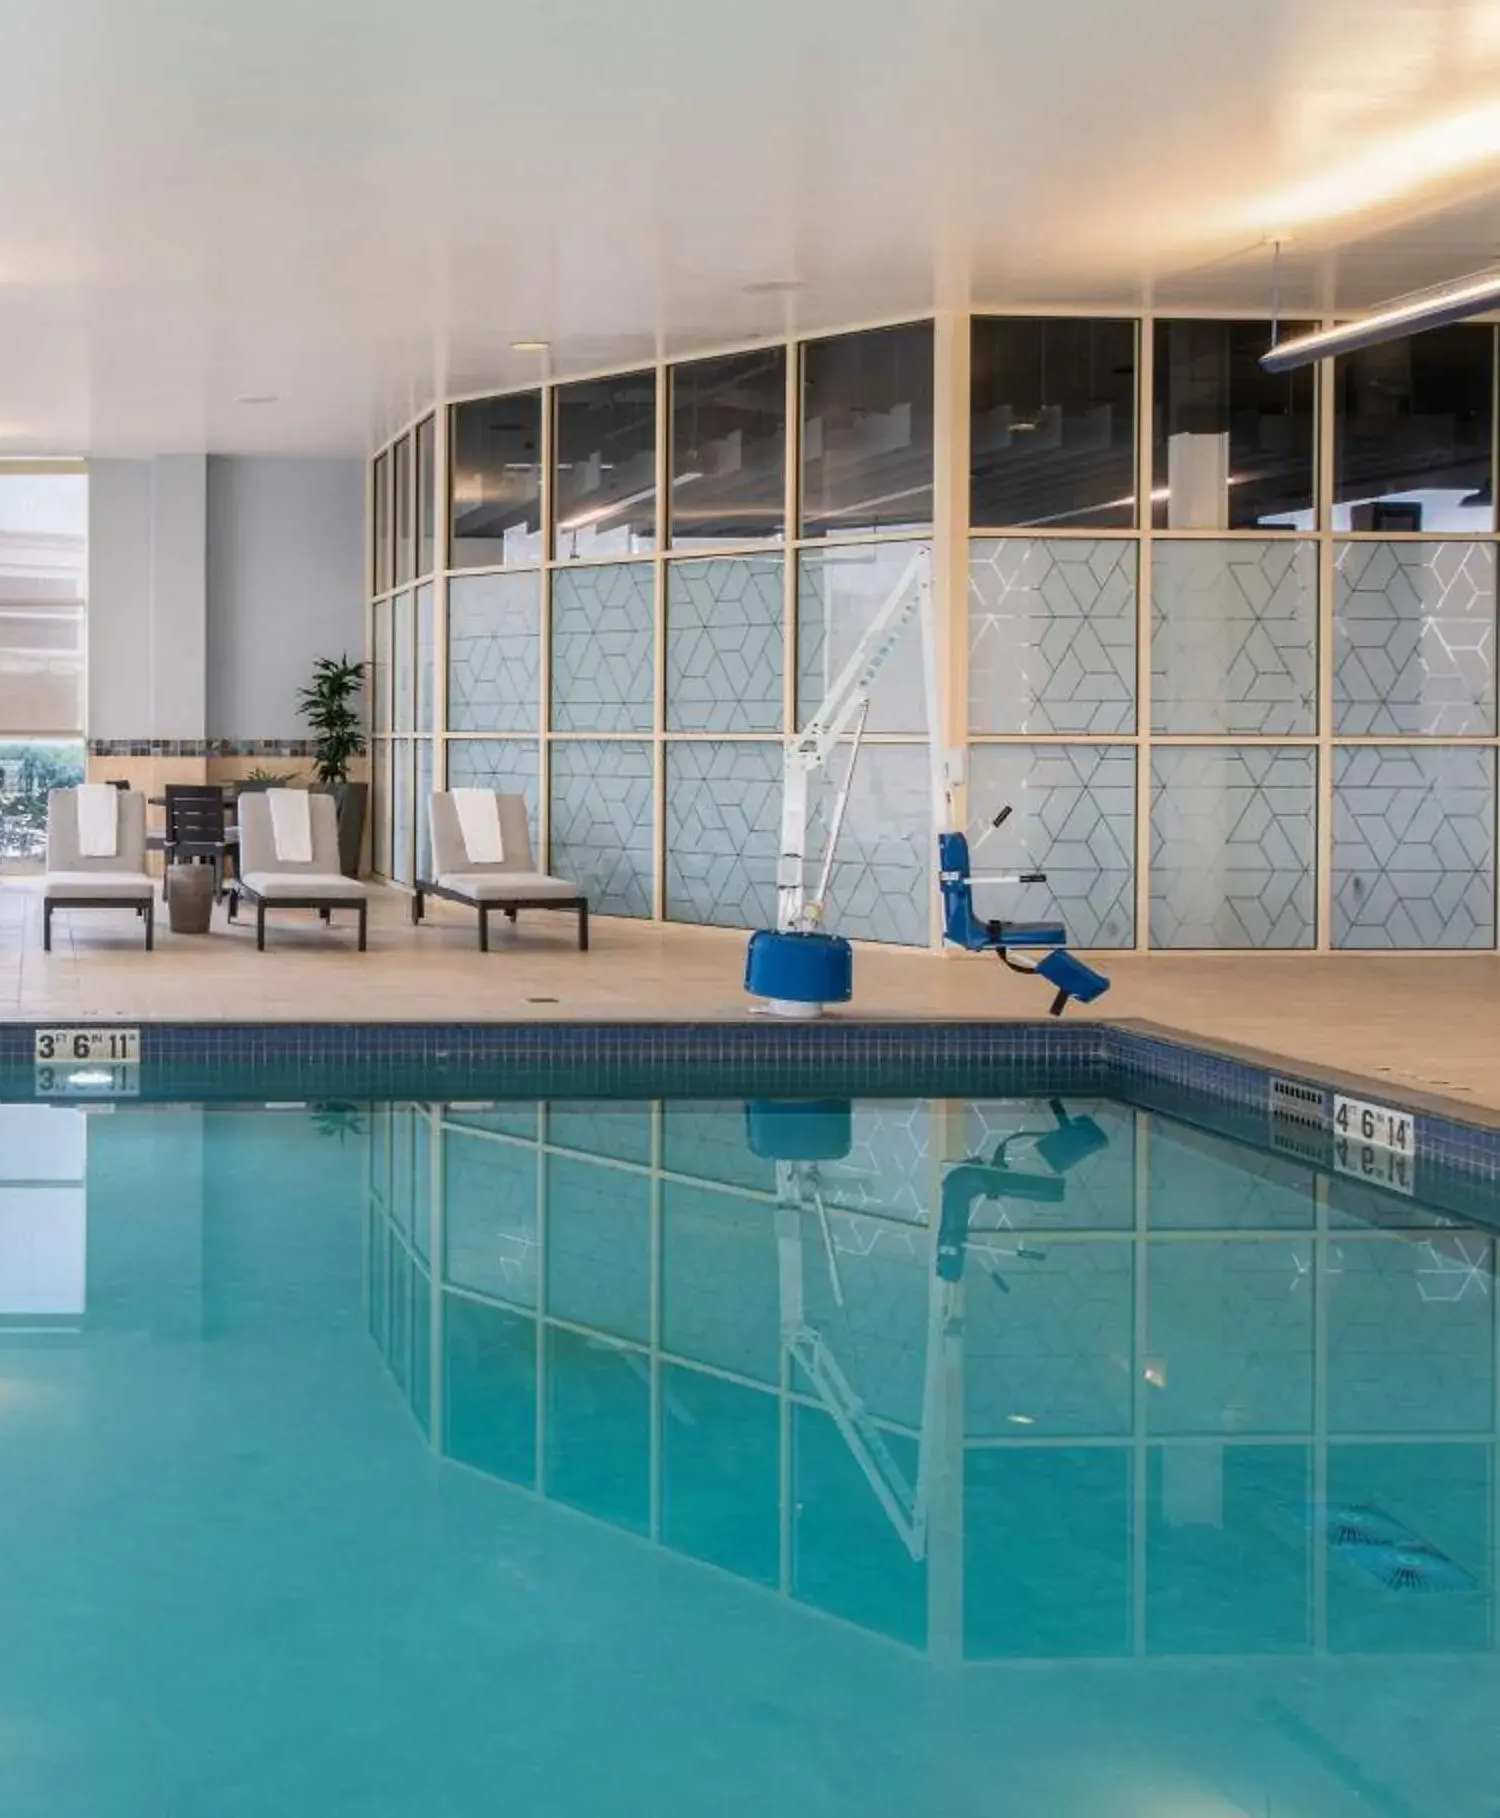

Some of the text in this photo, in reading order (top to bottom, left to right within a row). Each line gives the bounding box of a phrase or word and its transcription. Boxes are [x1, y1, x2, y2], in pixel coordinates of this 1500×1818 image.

[39, 1034, 55, 1059] 3
[73, 1034, 90, 1059] 6
[109, 1034, 127, 1059] 11
[1336, 1103, 1349, 1133] 4
[1362, 1109, 1375, 1139] 6
[1388, 1115, 1406, 1150] 14
